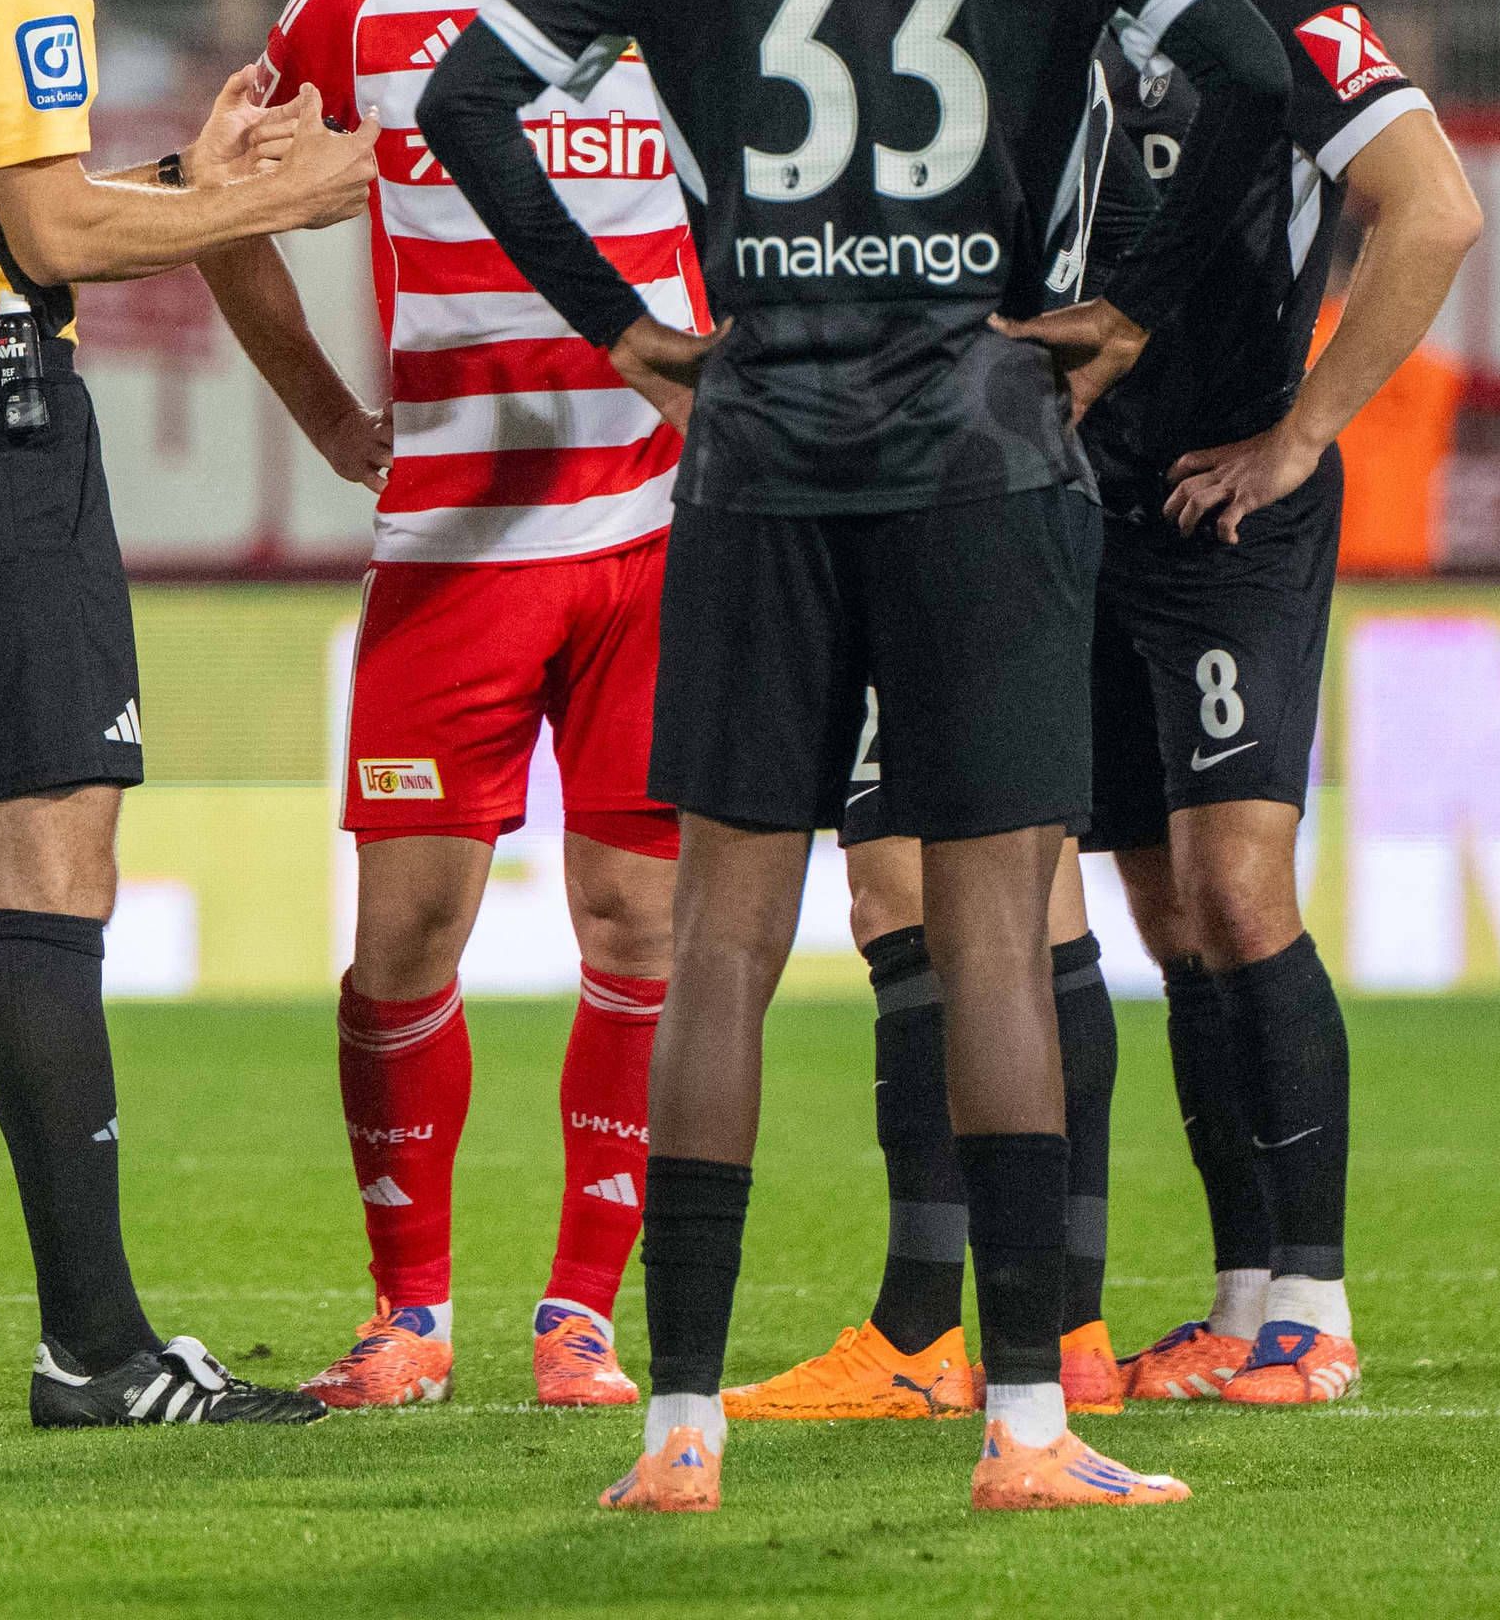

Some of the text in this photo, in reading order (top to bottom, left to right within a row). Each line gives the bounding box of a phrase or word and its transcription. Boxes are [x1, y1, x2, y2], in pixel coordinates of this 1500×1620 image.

[37, 90, 83, 105] Das Örtliche
[734, 221, 1001, 286] makengo
[1196, 648, 1246, 740] 8
[400, 775, 434, 790] UNION
